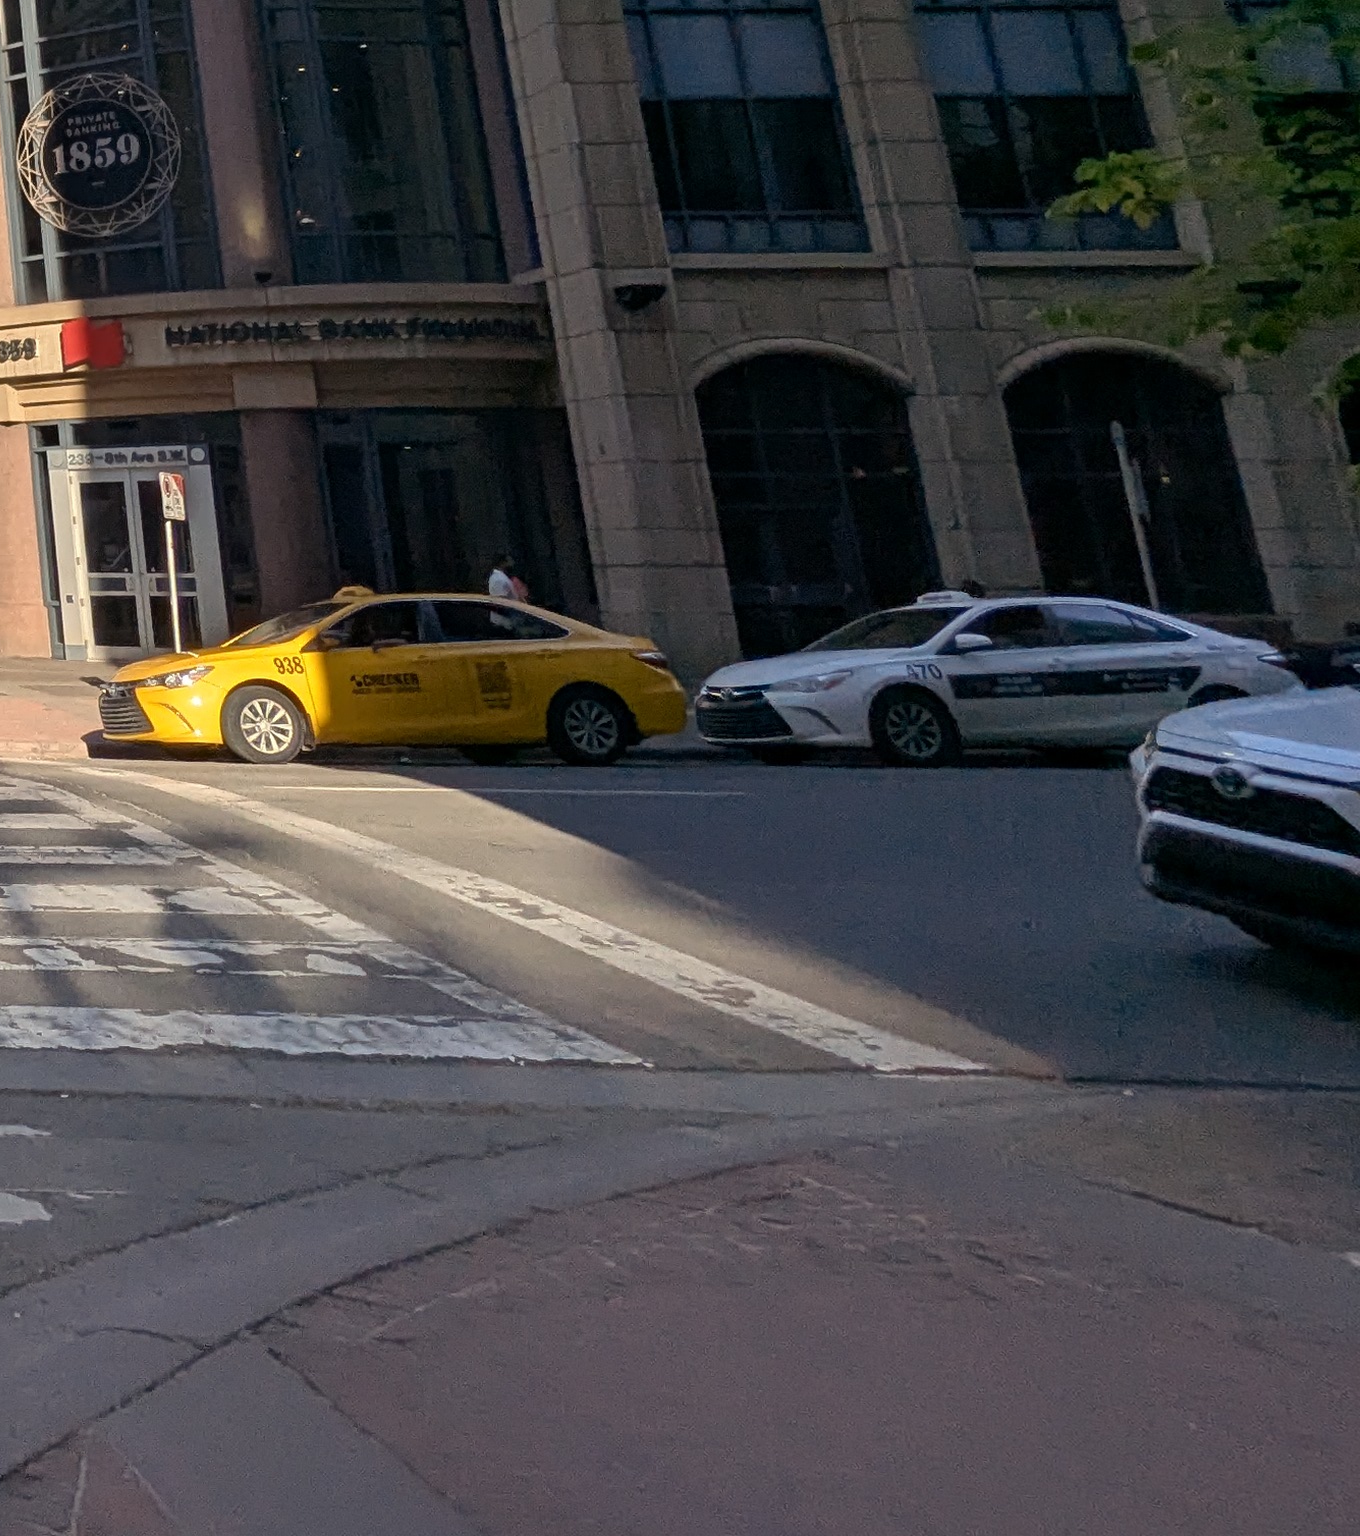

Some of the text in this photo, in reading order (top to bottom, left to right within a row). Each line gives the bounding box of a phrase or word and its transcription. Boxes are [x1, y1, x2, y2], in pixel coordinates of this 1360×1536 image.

[67, 111, 116, 126] PRIVATE
[66, 121, 121, 138] BANKING
[52, 133, 140, 175] 1859
[165, 321, 311, 346] NATIONAL
[273, 656, 305, 675] 938
